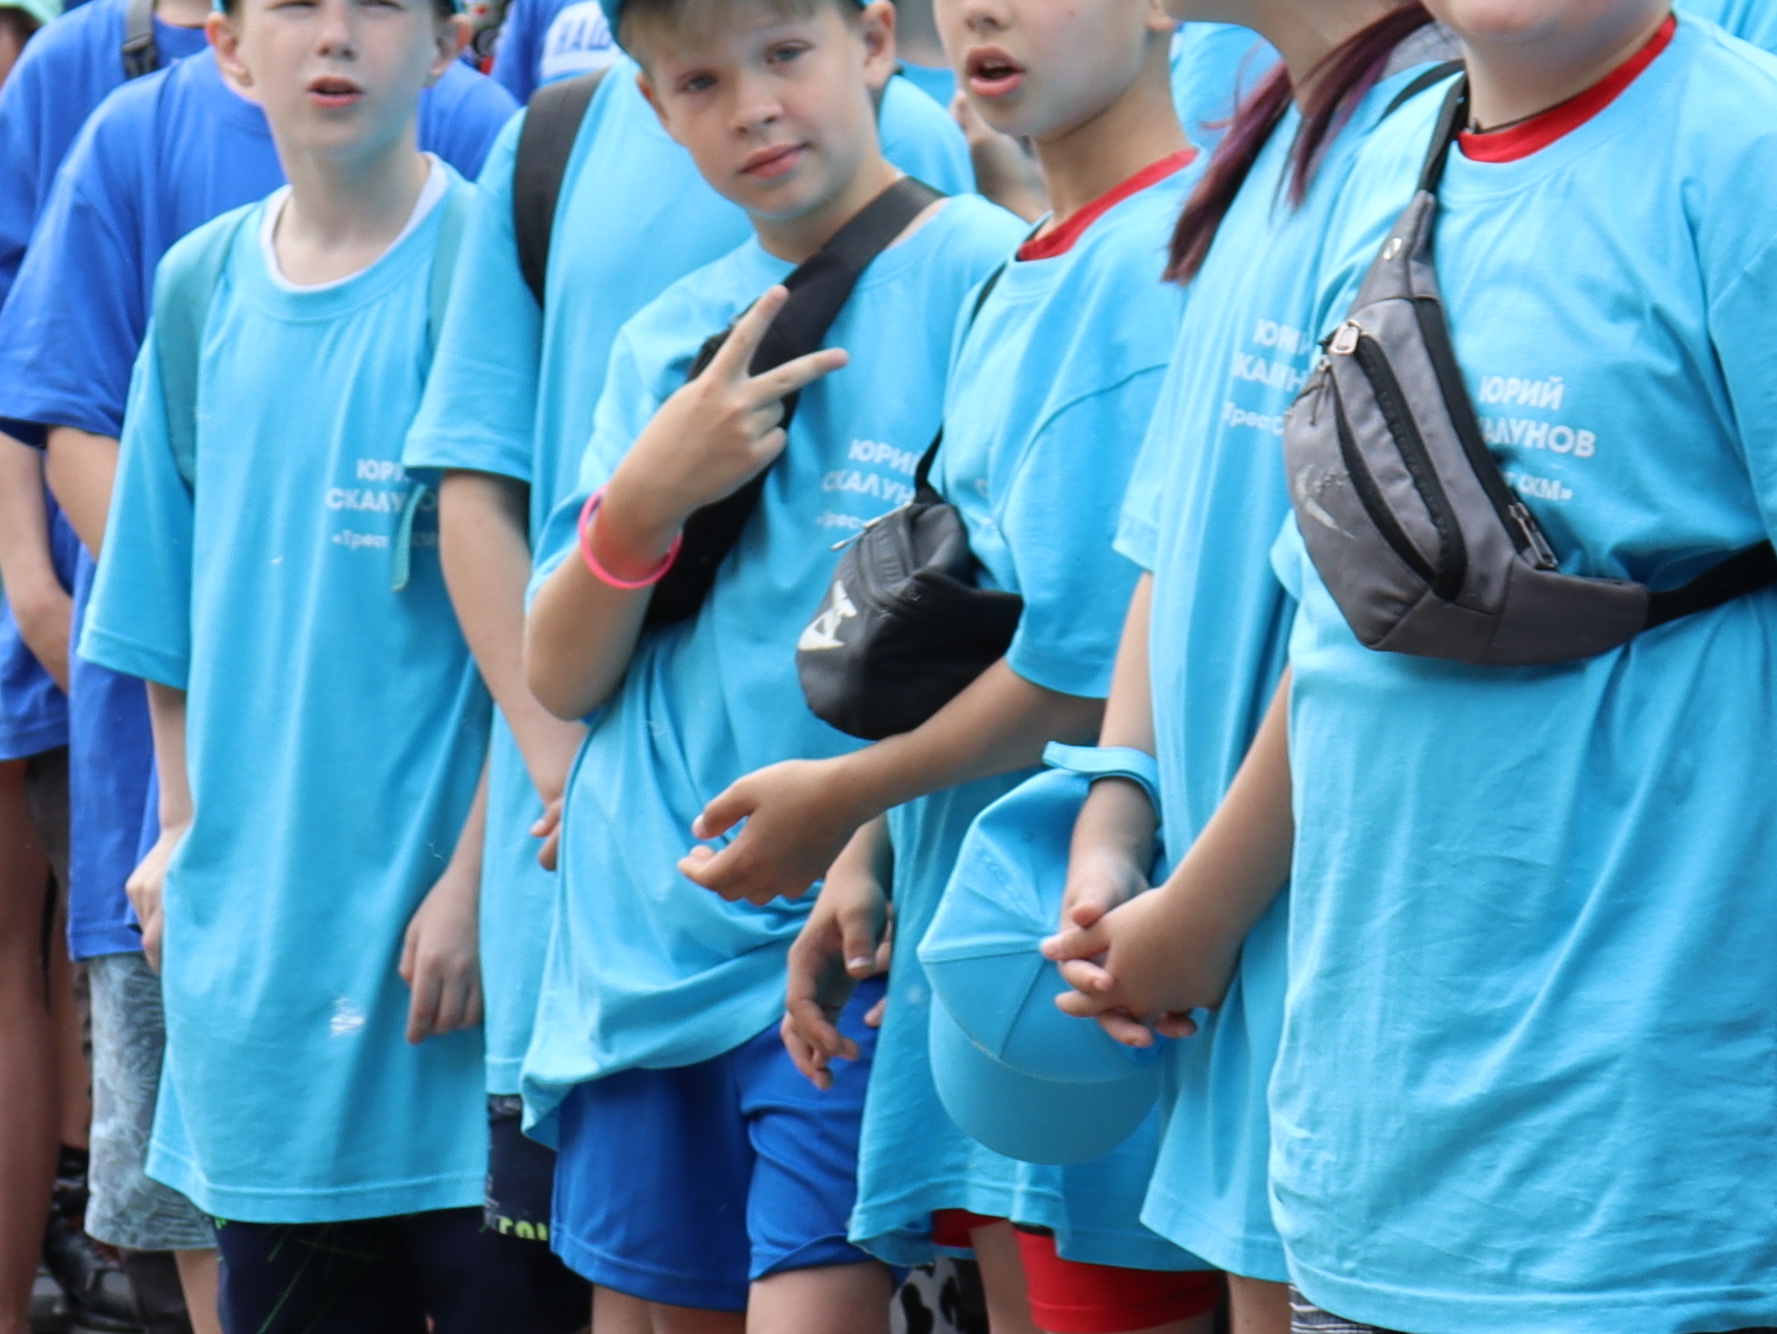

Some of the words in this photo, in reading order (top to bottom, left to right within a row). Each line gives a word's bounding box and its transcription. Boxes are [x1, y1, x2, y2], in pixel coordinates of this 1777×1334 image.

[1479, 375, 1564, 410] ЮРИЙ
[1480, 417, 1597, 458] АЛУНОВ
[822, 469, 917, 505] СКАЛУН
